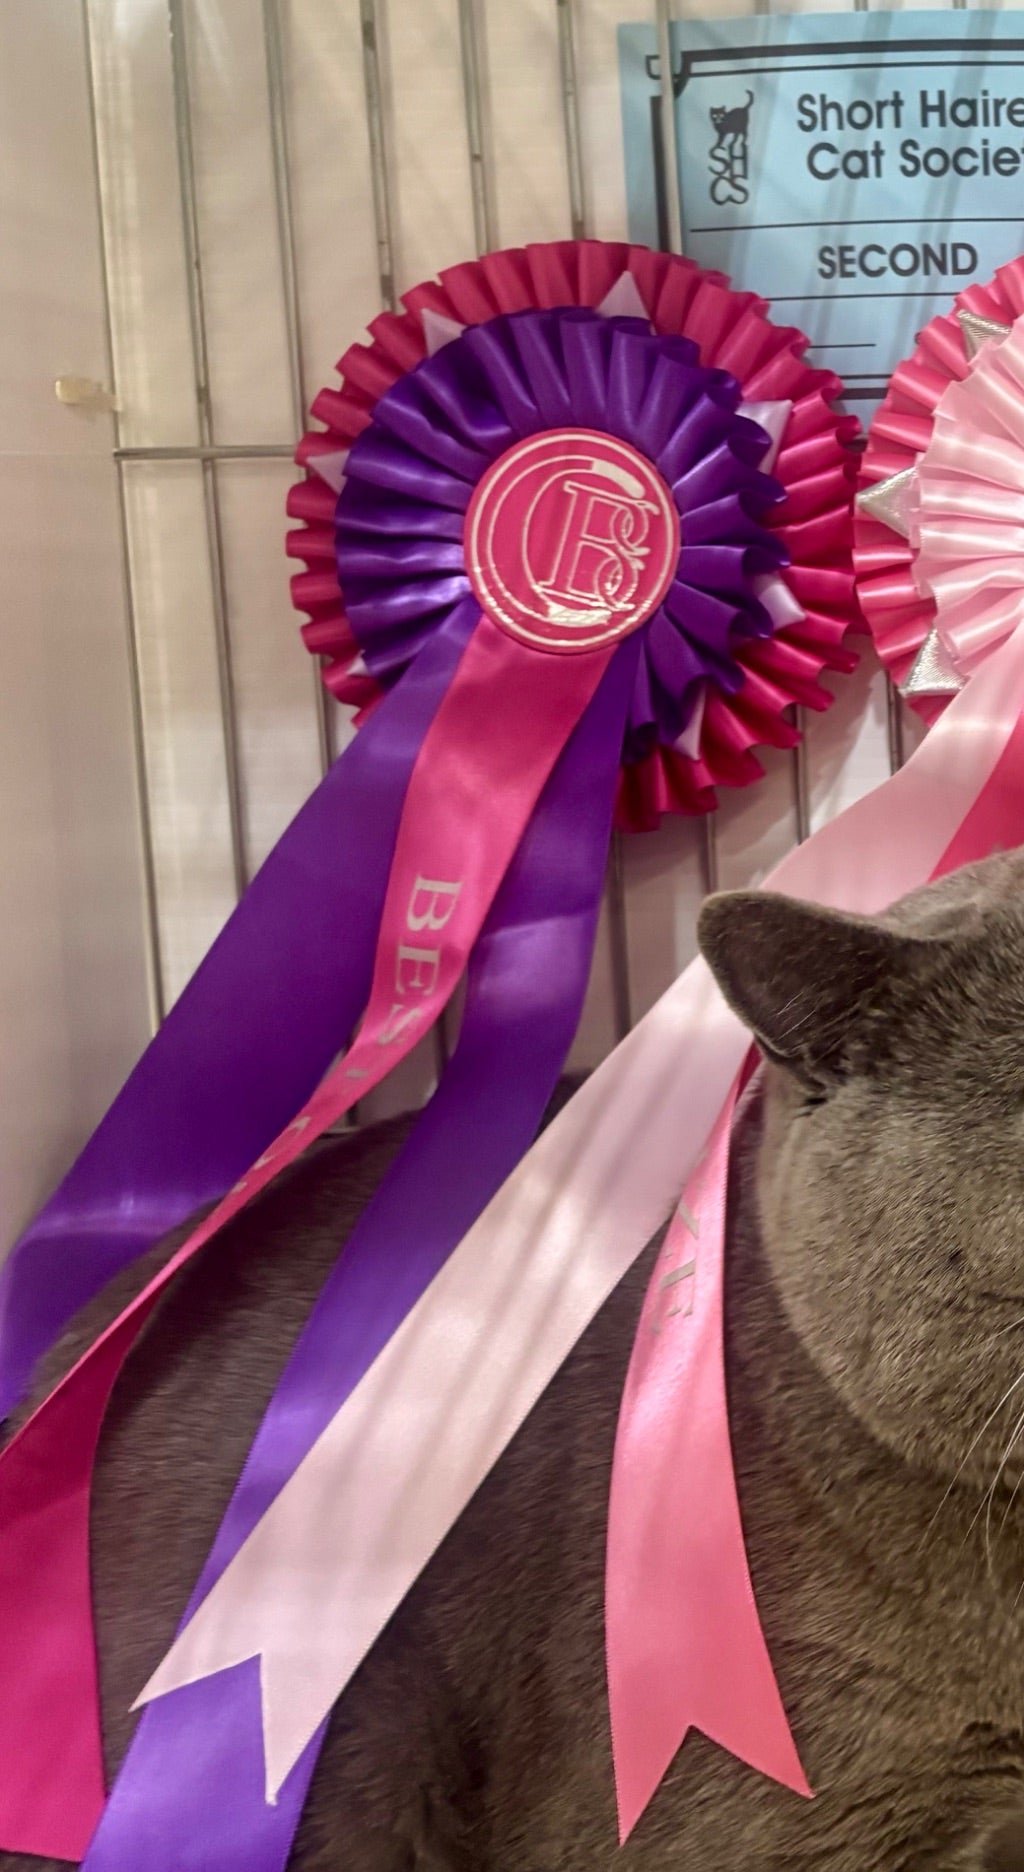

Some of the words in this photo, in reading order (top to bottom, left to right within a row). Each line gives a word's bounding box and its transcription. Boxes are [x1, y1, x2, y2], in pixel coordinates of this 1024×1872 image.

[797, 92, 904, 133] Short
[807, 142, 885, 181] Cat
[818, 243, 978, 279] SECOND
